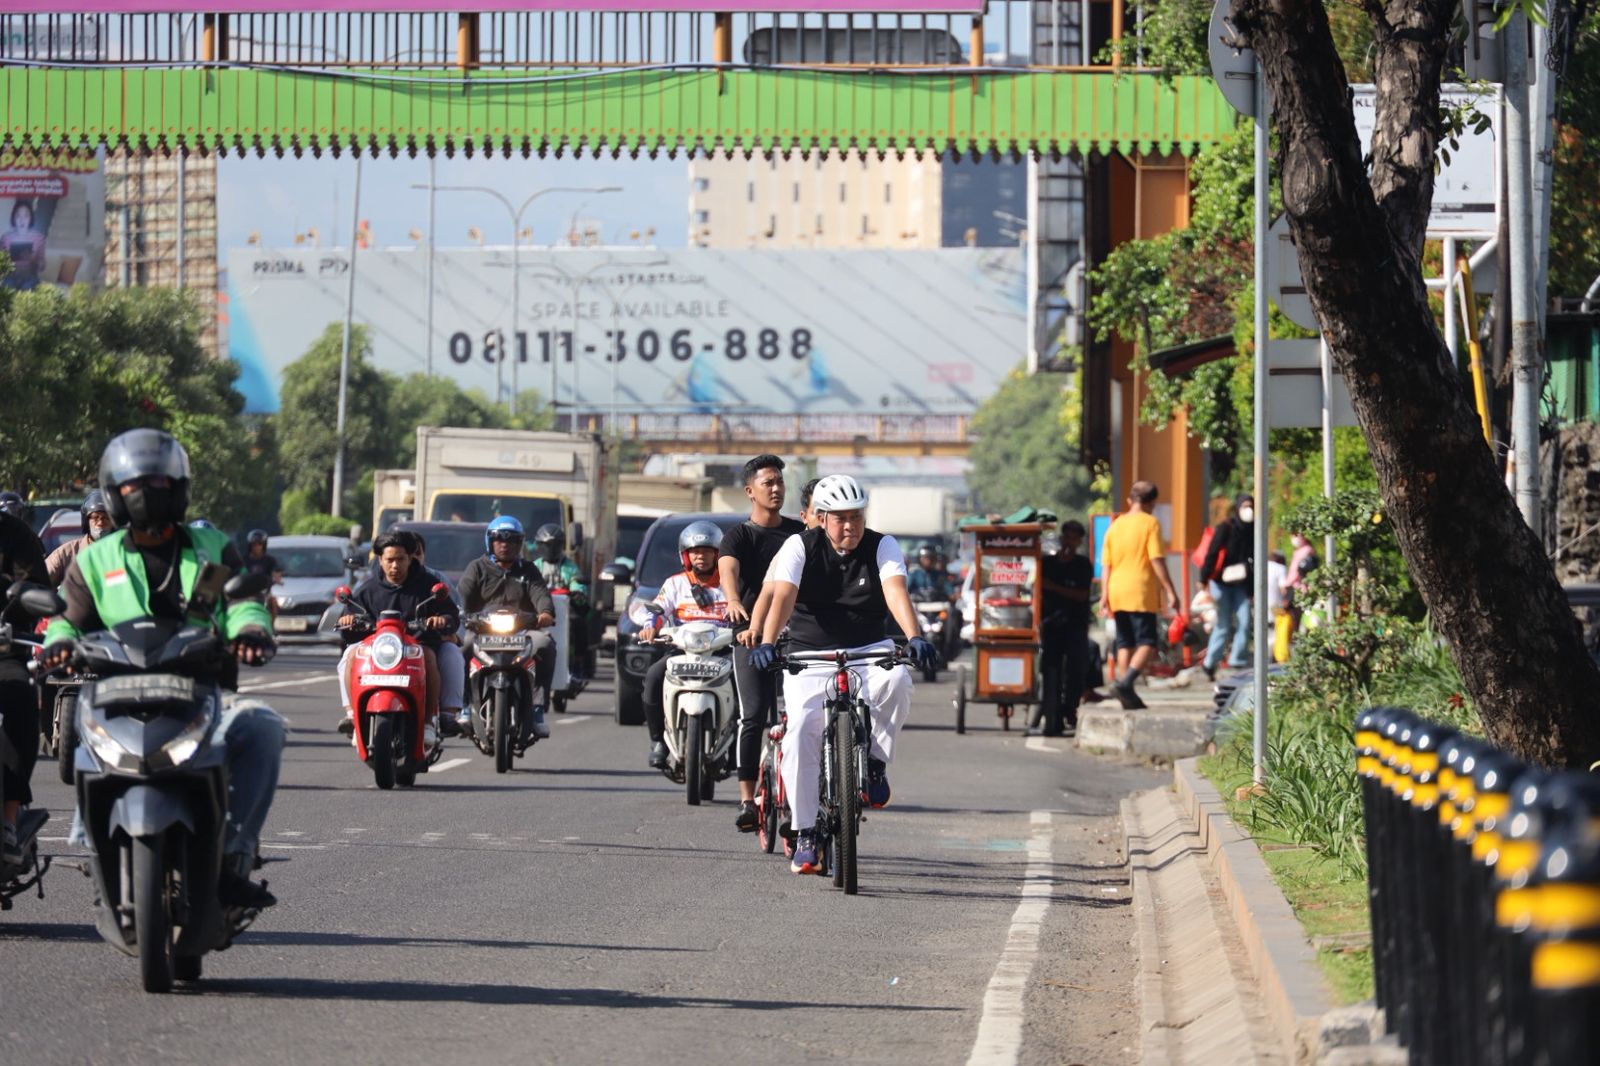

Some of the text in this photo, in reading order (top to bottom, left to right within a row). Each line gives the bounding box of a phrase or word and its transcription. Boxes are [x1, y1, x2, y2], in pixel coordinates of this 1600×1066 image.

[530, 300, 730, 320] SPACE AVAILABLE
[449, 328, 812, 363] 08111-306-888
